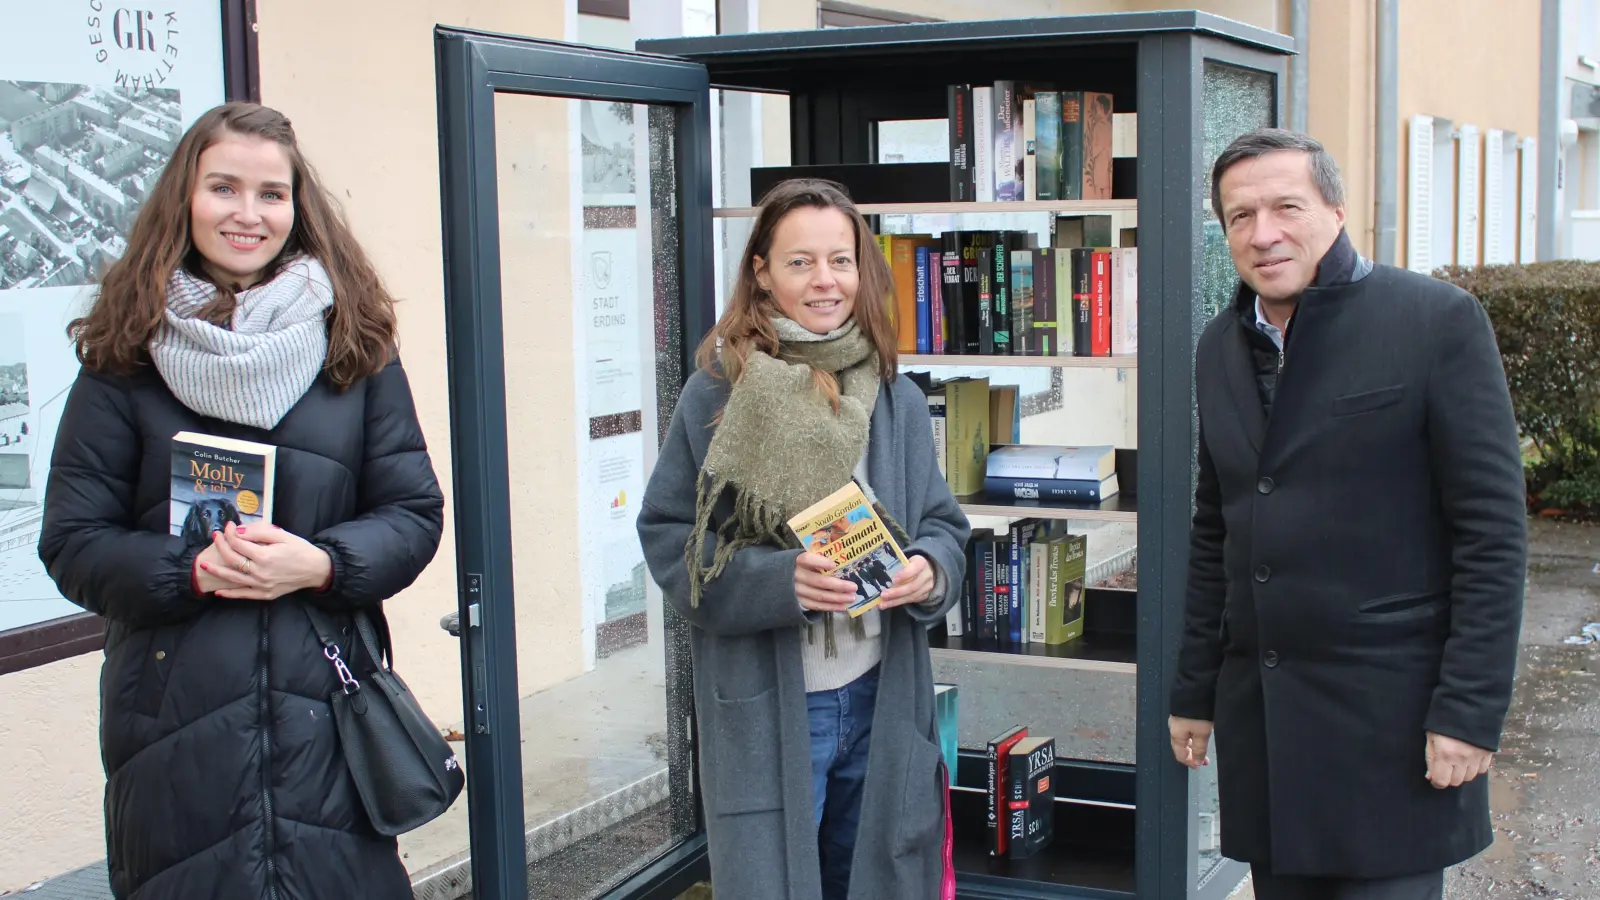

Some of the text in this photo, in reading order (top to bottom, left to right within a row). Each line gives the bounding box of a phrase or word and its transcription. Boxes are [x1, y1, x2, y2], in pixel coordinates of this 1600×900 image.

[113, 8, 156, 52] GK
[115, 11, 179, 94] KLETTHAM
[946, 266, 956, 274] DER
[995, 244, 1004, 271] SCHÖPFER
[916, 265, 925, 302] Erbschaft
[996, 271, 1004, 283] DER
[593, 296, 619, 310] STADT
[593, 313, 626, 328] ERDING
[194, 450, 241, 464] Colin Butcher
[189, 459, 245, 489] Molly
[193, 479, 227, 494] & ich
[814, 513, 834, 528] Noah
[834, 498, 862, 517] Gordon
[833, 520, 878, 552] Diamant
[840, 532, 884, 562] Salomon
[984, 551, 993, 625] ELIZABETH GEORGE
[1028, 744, 1054, 774] YRSA
[1012, 810, 1021, 839] YRSA
